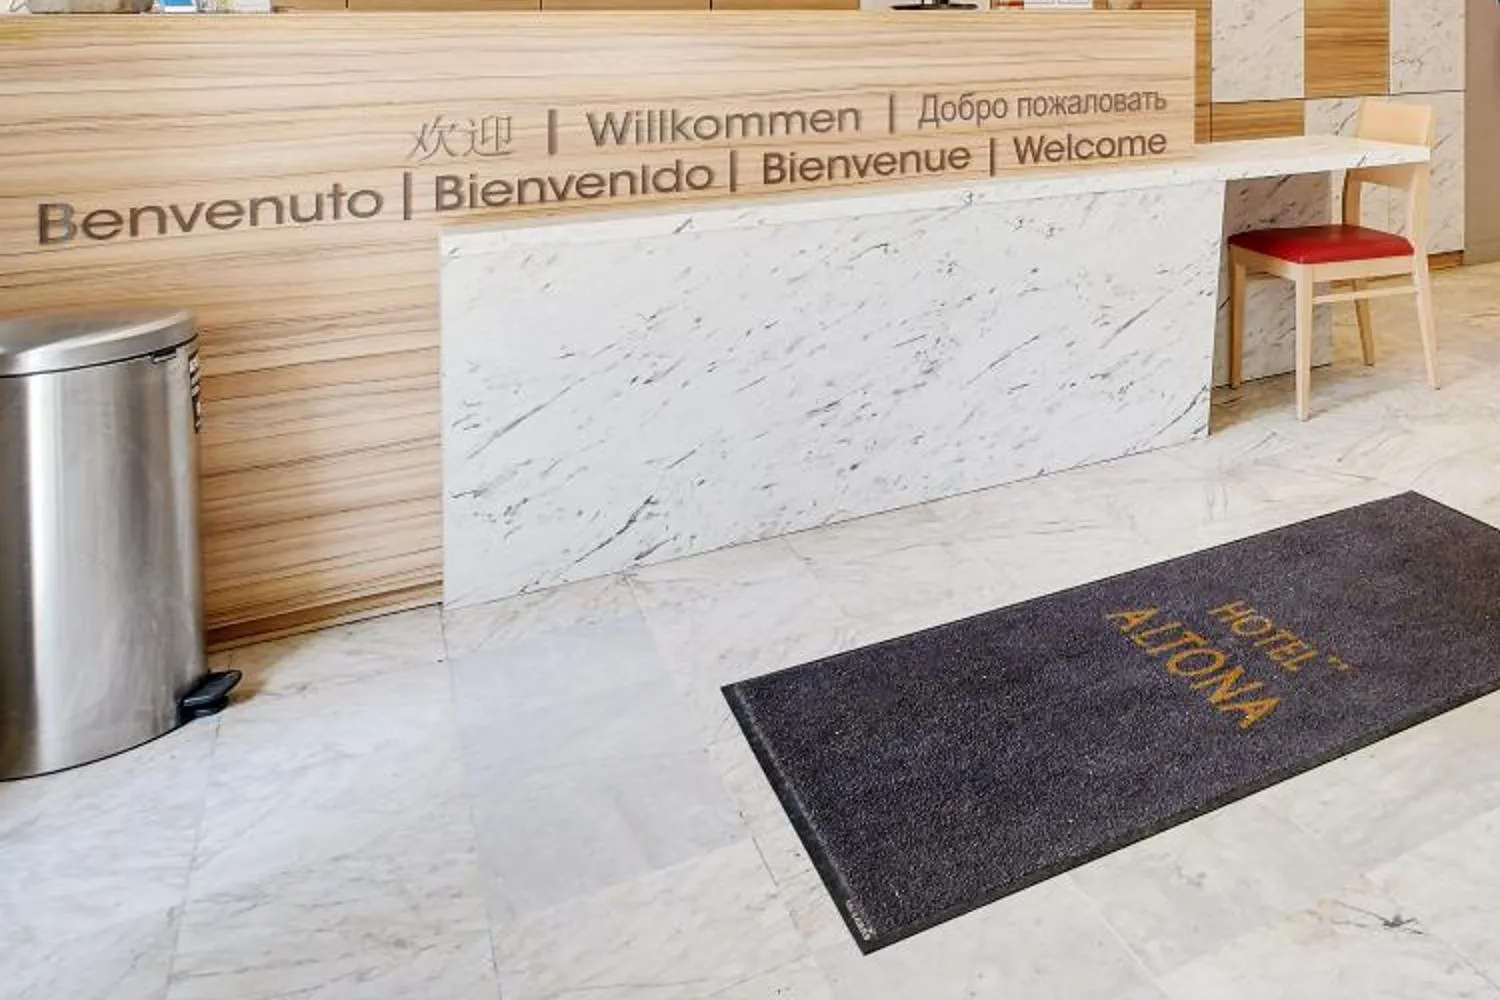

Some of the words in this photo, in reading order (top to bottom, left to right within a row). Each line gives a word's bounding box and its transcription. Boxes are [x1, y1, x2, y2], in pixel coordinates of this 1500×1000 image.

[405, 113, 514, 162] 欢迎
[586, 105, 864, 147] Willkommen
[917, 91, 1009, 128] Добро
[1017, 87, 1168, 119] пожаловать
[37, 182, 385, 246] Benvenuto
[434, 159, 715, 212] Bienvenido
[762, 145, 971, 186] Bienvenue
[1012, 132, 1168, 165] Welcome
[1105, 603, 1281, 730] ALTONA
[1207, 599, 1319, 672] HOTEL
